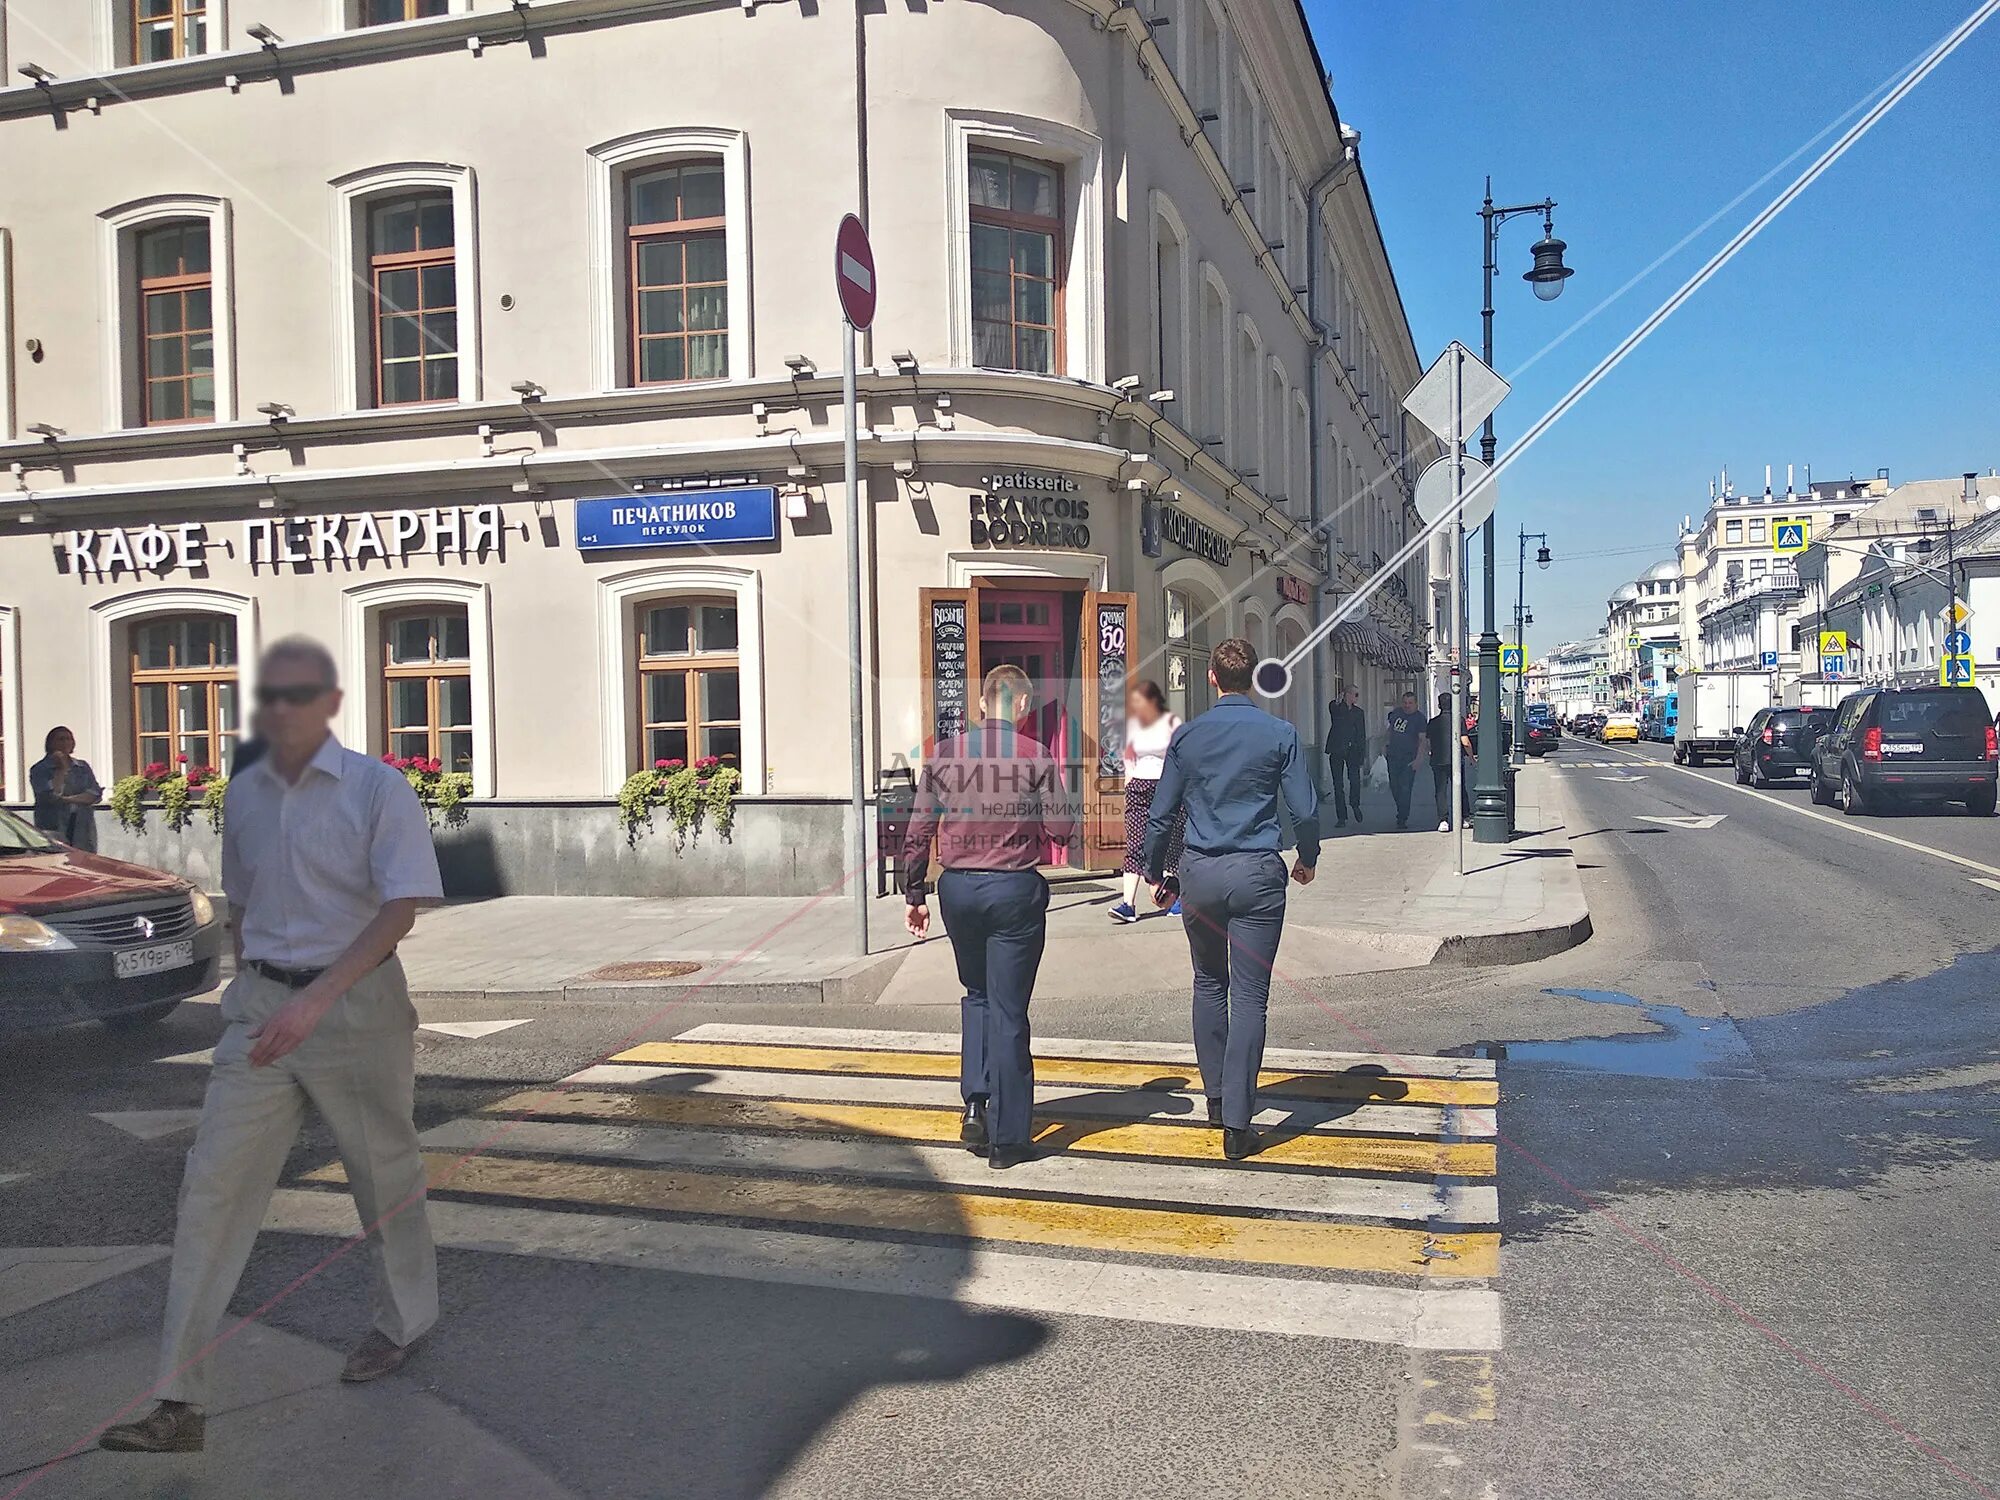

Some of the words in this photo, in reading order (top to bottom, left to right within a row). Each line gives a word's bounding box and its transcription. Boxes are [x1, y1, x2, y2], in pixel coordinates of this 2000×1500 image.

[992, 471, 1073, 493] patisserie
[612, 501, 736, 525] ПЕЧАТНИКОВ
[70, 522, 202, 573] КАФЕ
[243, 503, 500, 564] ПЕКАРНЯ
[642, 524, 706, 536] ПЕРЕУЛОК
[1168, 506, 1230, 567] КОНДИТЕРСКАЯ
